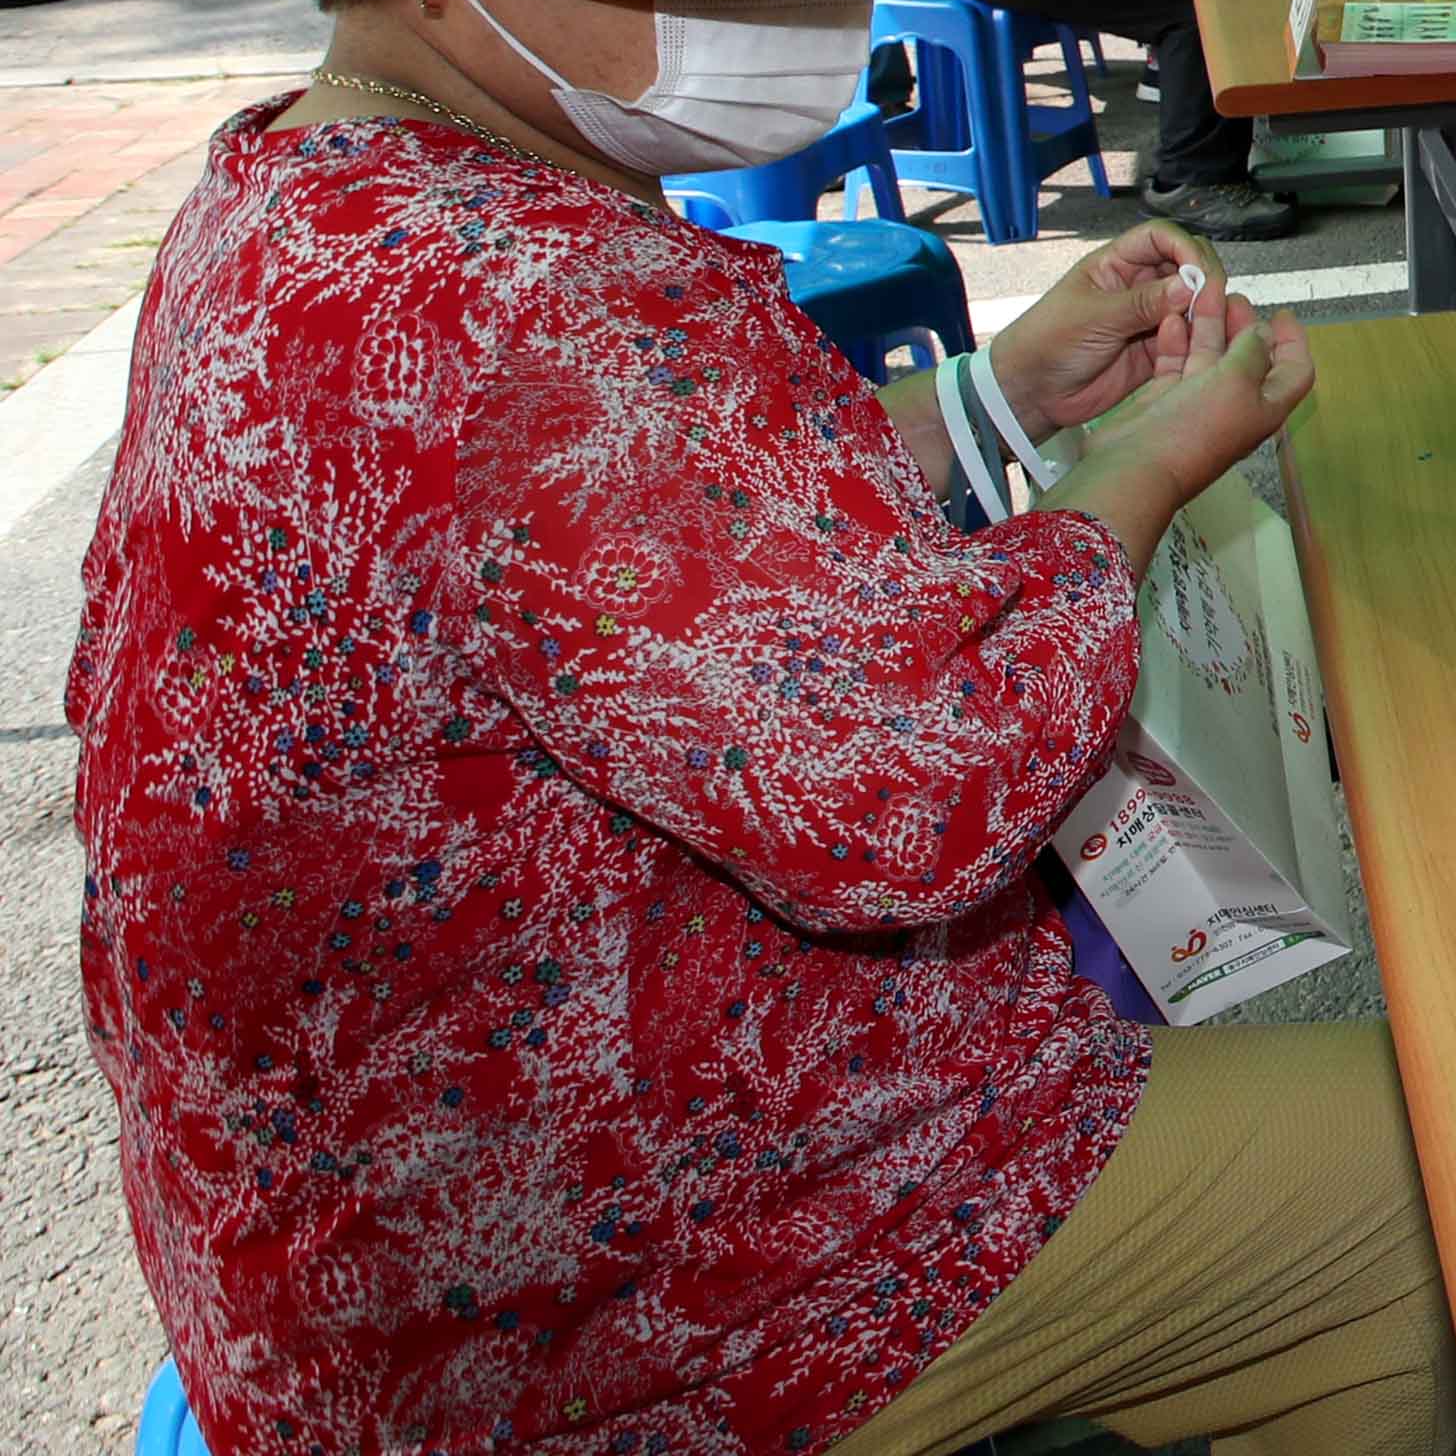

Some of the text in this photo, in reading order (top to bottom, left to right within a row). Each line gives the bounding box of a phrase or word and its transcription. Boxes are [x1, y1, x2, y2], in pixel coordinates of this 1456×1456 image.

[1109, 788, 1196, 833] 1899-9988
[1115, 802, 1207, 848] 치매상담콜센터
[1206, 903, 1279, 927] 치매안심센터
